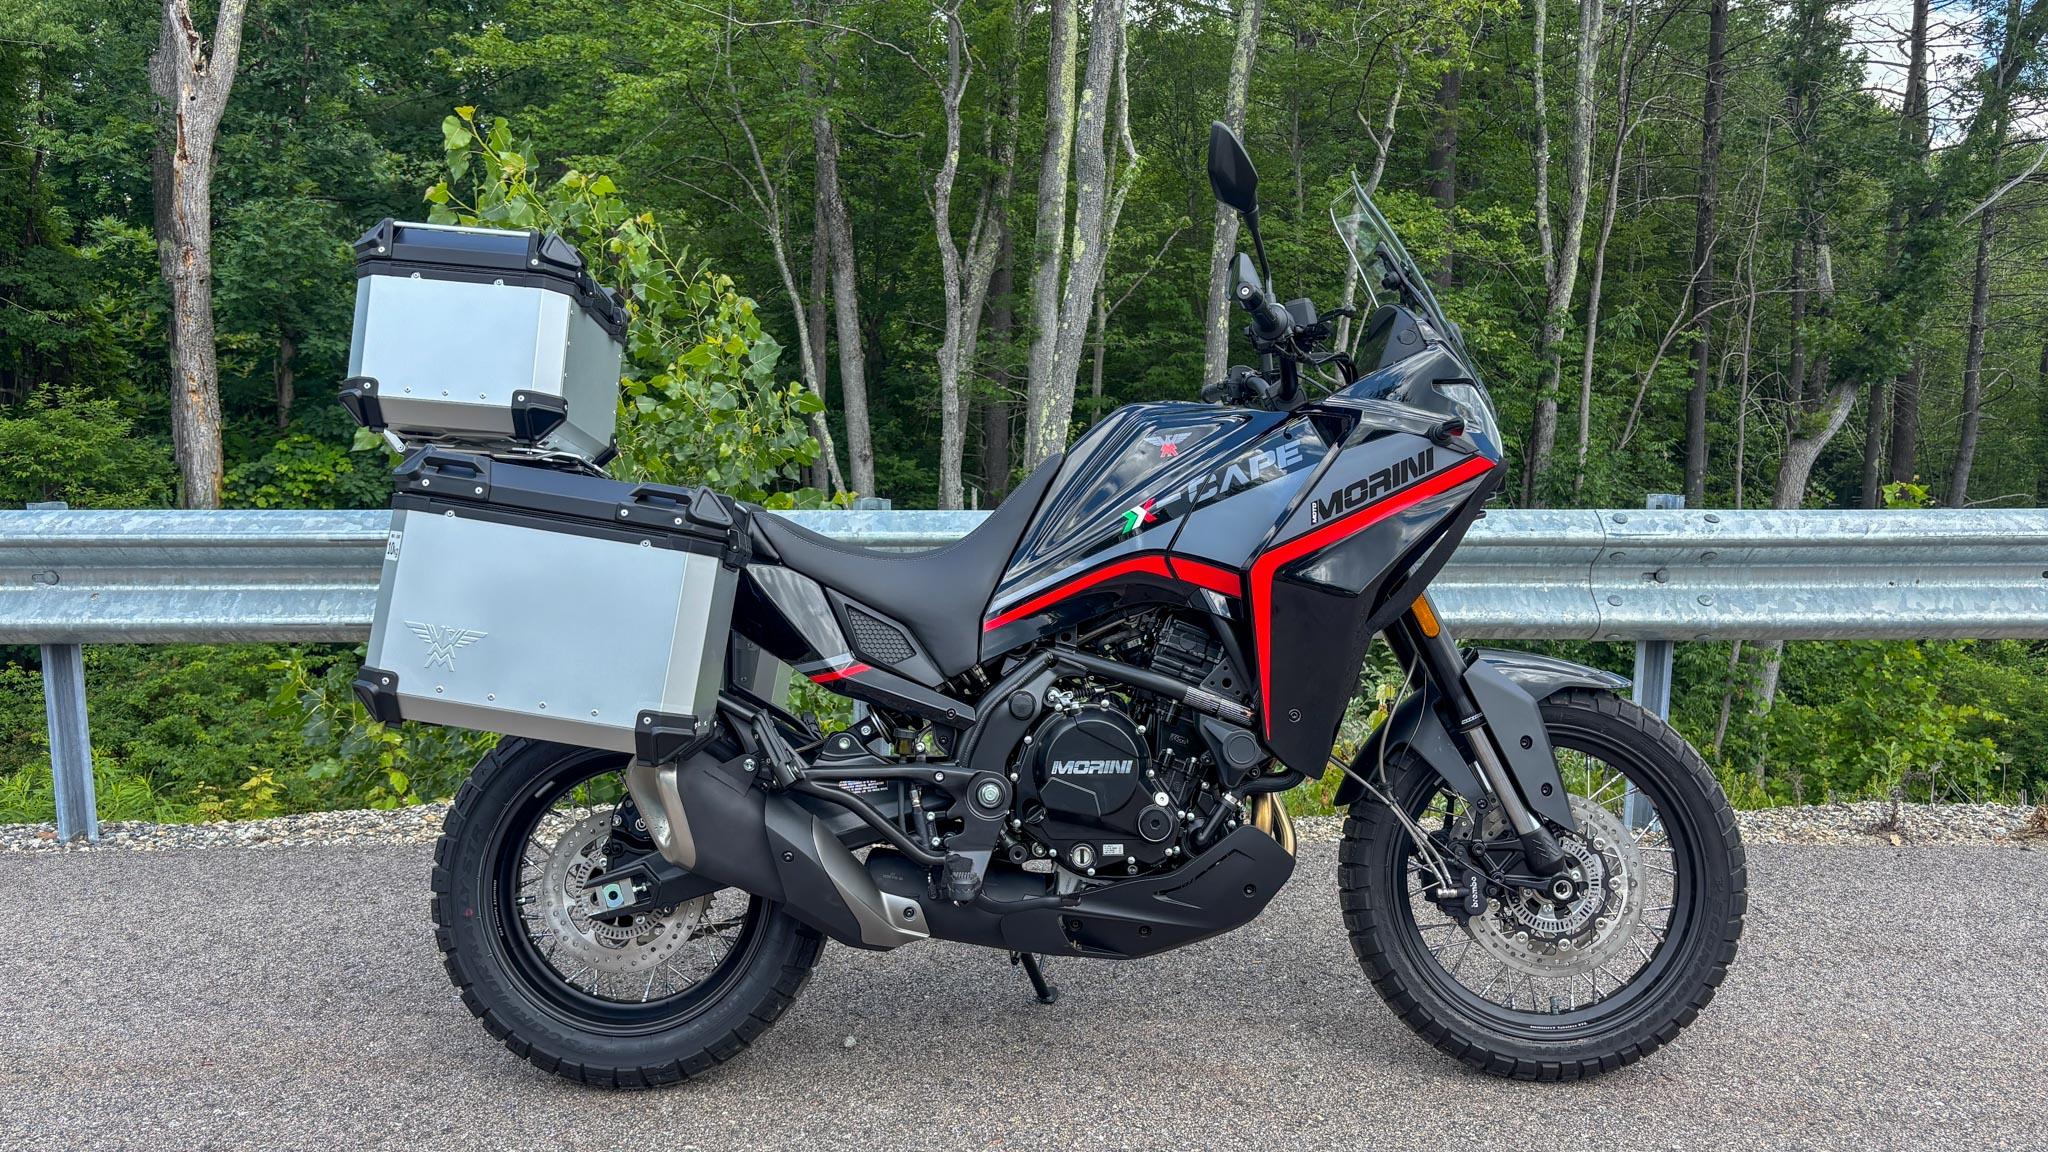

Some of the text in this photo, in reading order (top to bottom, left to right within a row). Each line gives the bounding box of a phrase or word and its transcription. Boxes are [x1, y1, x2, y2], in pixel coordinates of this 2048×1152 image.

[1318, 446, 1434, 520] MORINI
[1051, 760, 1133, 774] MORINI
[1471, 876, 1479, 907] brembo
